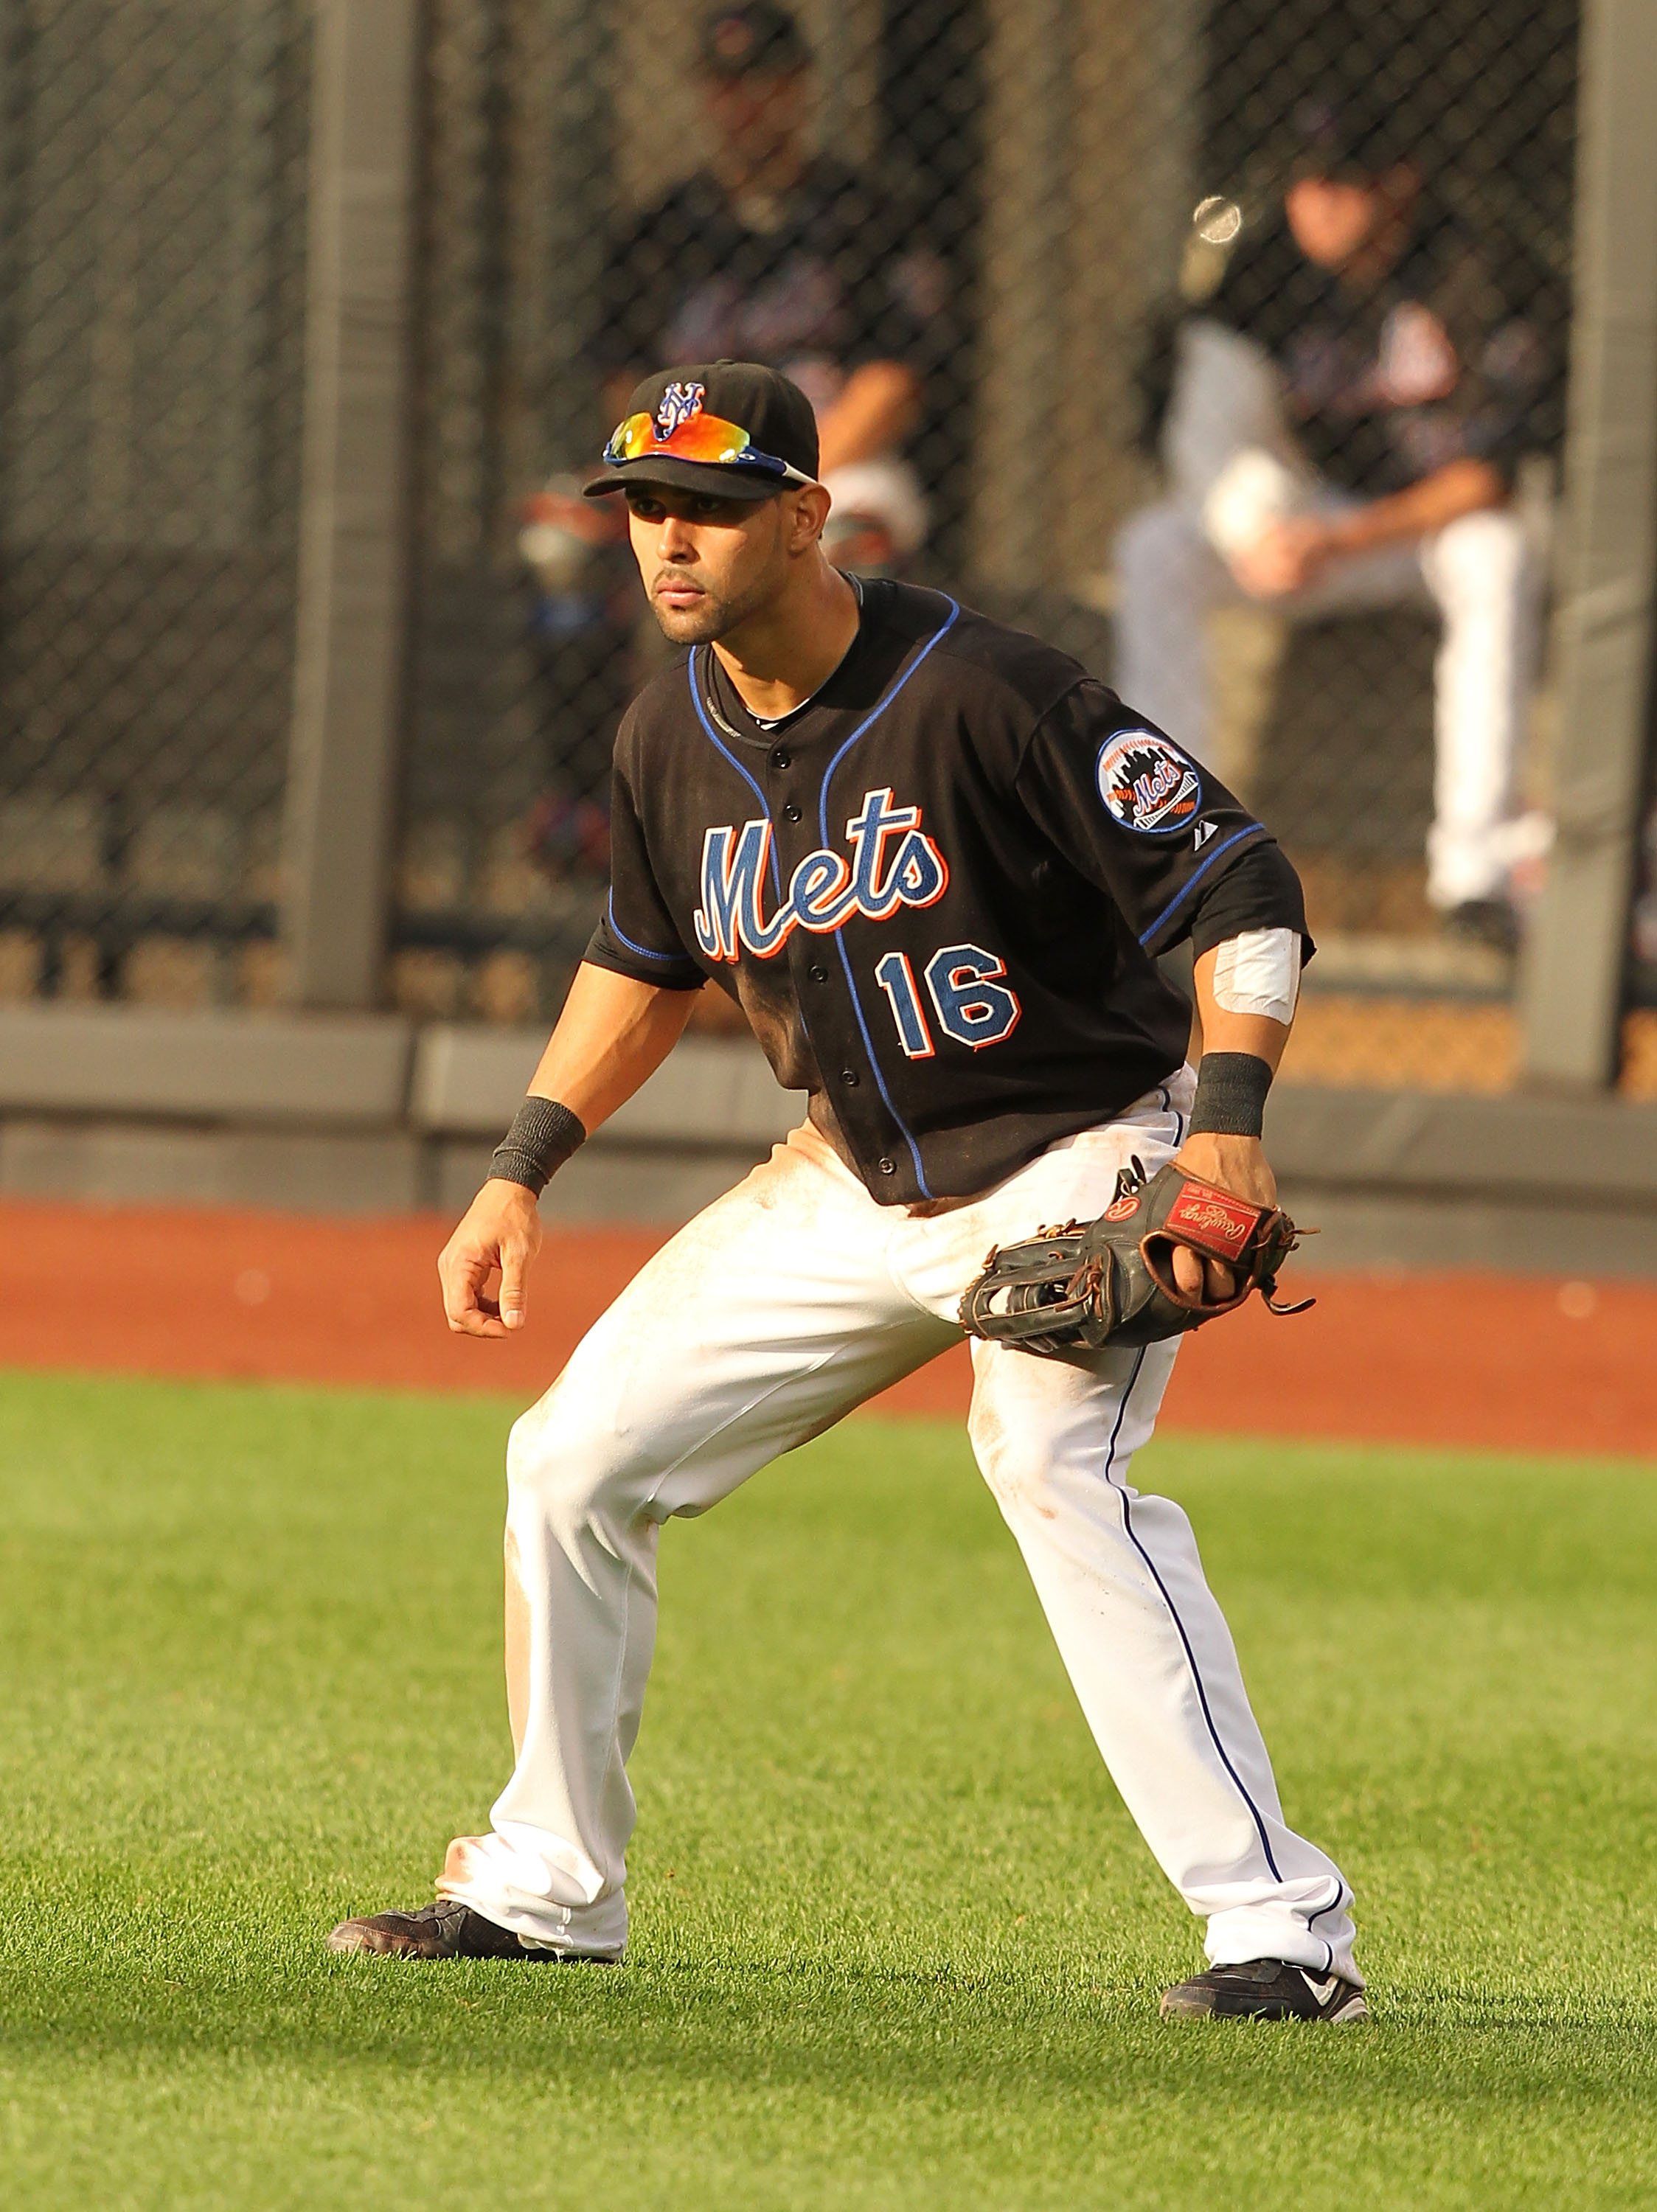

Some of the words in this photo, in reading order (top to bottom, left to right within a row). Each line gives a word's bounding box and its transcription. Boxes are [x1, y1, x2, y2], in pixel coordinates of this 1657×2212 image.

[1133, 759, 1182, 817] Mets
[694, 787, 950, 964] Mets
[875, 944, 1023, 1059] 16
[1179, 1203, 1246, 1240] Rawlings
